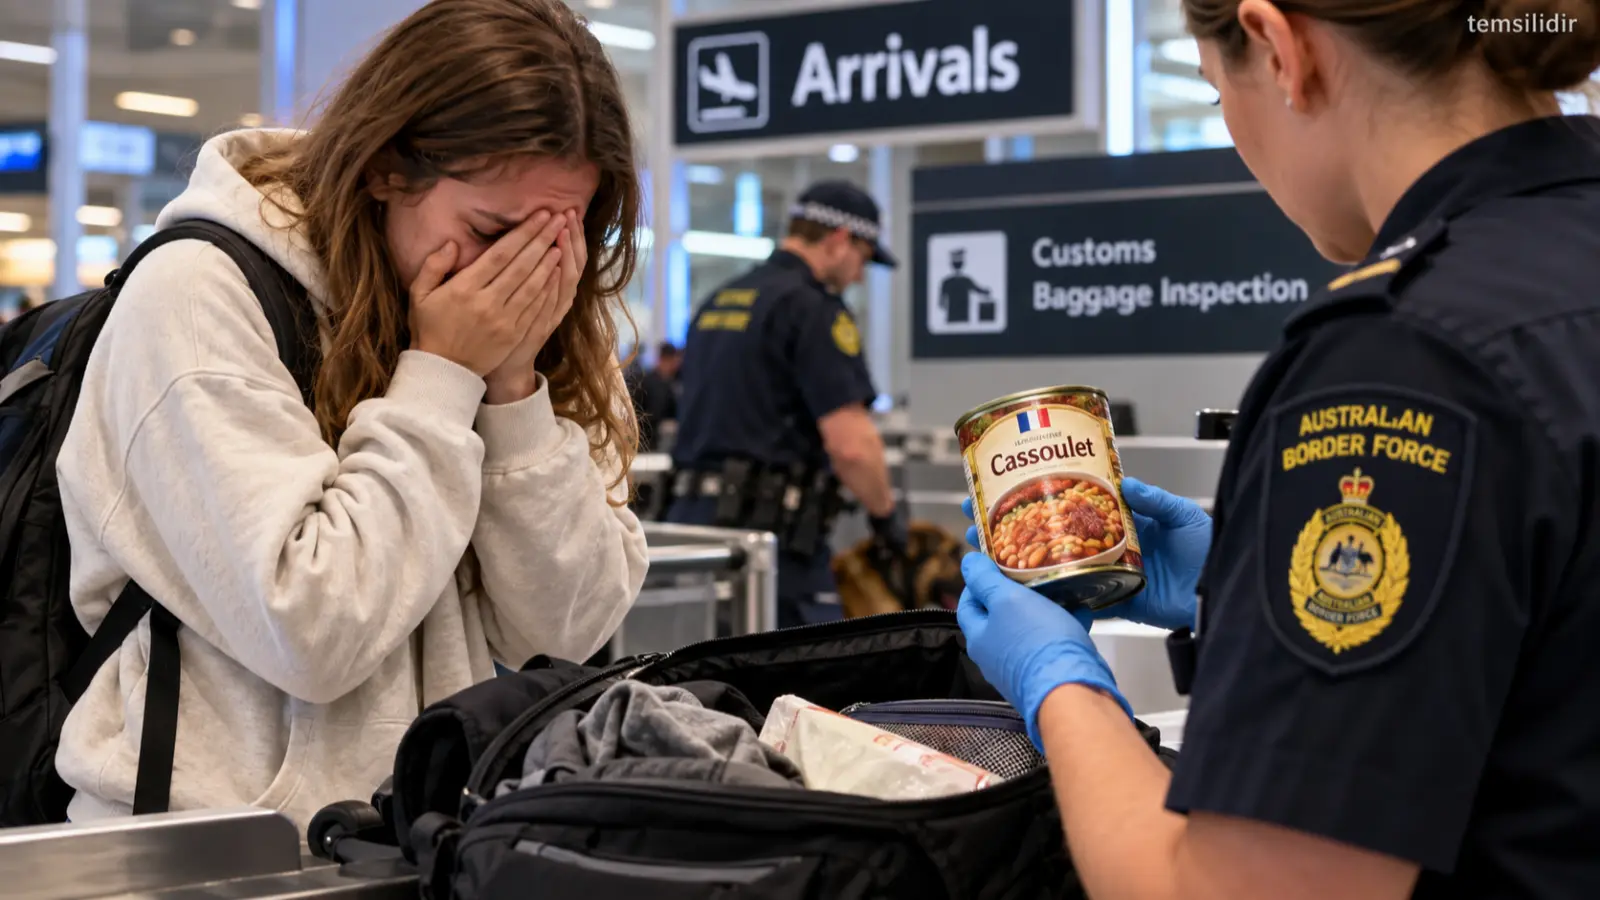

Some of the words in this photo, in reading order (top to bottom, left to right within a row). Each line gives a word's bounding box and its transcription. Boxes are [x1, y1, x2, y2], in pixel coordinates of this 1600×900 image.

[791, 24, 1021, 107] Arrivals
[1032, 237, 1157, 268] Customs
[1032, 280, 1153, 318] Baggage
[1159, 272, 1309, 312] Inspection
[991, 436, 1095, 476] Cassoulet
[1282, 434, 1365, 471] BORDER
[1372, 434, 1451, 473] FORCE
